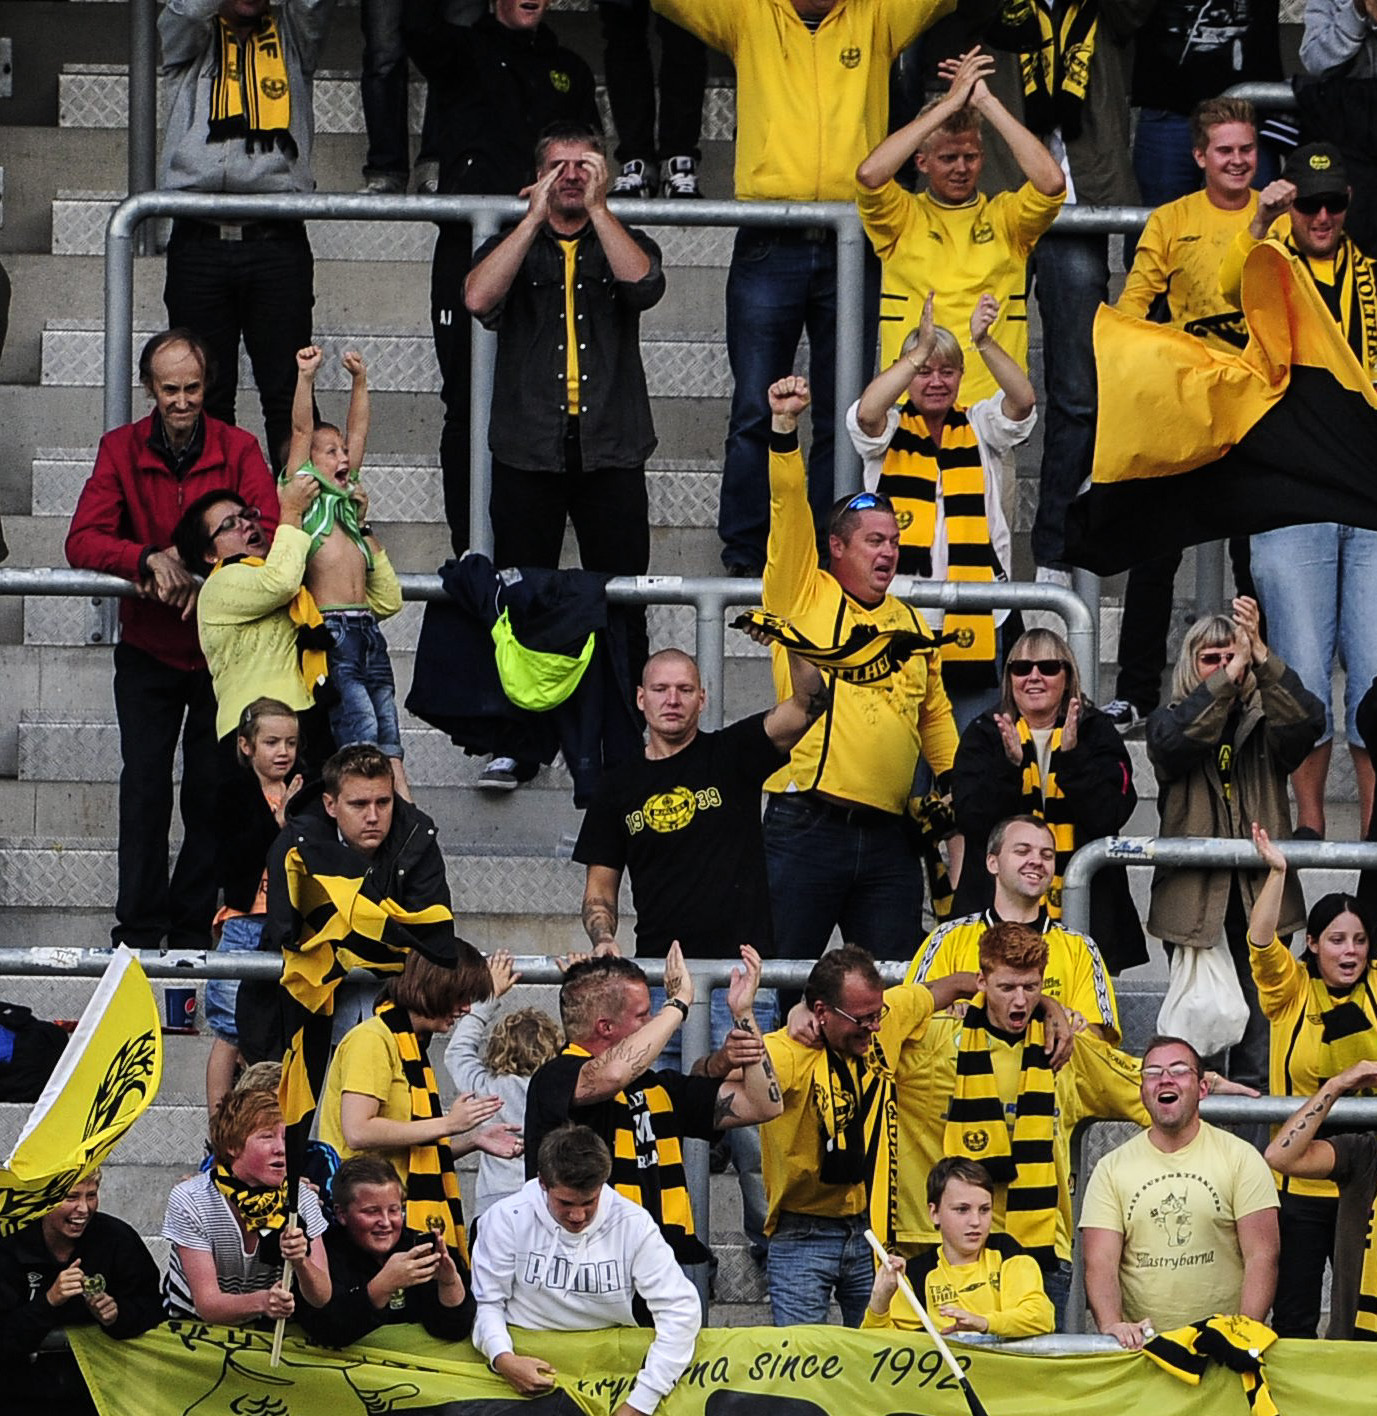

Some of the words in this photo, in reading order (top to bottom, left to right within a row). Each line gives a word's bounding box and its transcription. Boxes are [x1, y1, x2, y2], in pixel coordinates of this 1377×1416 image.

[695, 786, 722, 811] 39
[625, 810, 645, 836] 19
[524, 1251, 620, 1295] PUMA
[747, 1340, 844, 1382] since
[870, 1347, 973, 1391] 1992
